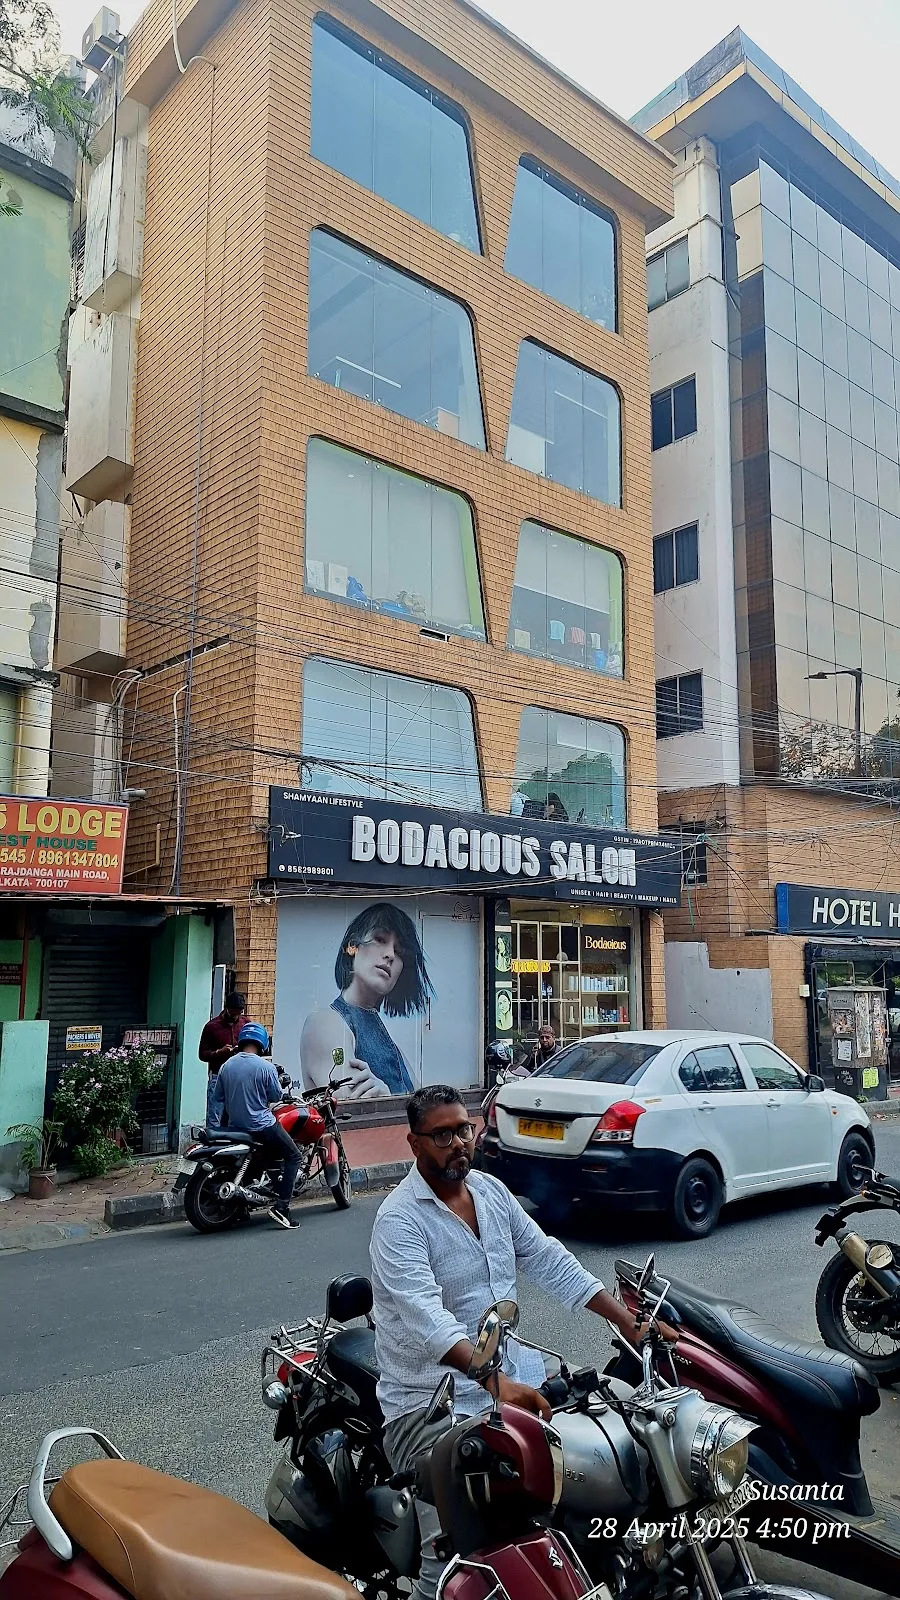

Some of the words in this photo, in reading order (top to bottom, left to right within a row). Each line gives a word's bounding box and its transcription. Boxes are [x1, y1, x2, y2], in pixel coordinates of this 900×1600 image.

[283, 791, 328, 804] SHAMYAAN
[329, 797, 363, 809] LIFESTYLE
[17, 803, 123, 838] LODGE
[36, 836, 98, 851] HOUSE
[352, 815, 540, 877] BODACIOUS
[550, 840, 637, 887] SALON
[0, 847, 26, 864] 545
[38, 849, 119, 868] 8961347804
[1, 866, 53, 877] RAJDANGA
[56, 869, 81, 878] MAIN
[82, 870, 110, 881] ROAD,
[35, 879, 69, 888] 700107
[596, 890, 609, 898] HAIR
[614, 892, 633, 900] BEAUTY
[638, 894, 658, 902] MAKEUP
[812, 896, 882, 927] HOTEL
[584, 936, 627, 950] Bodacious
